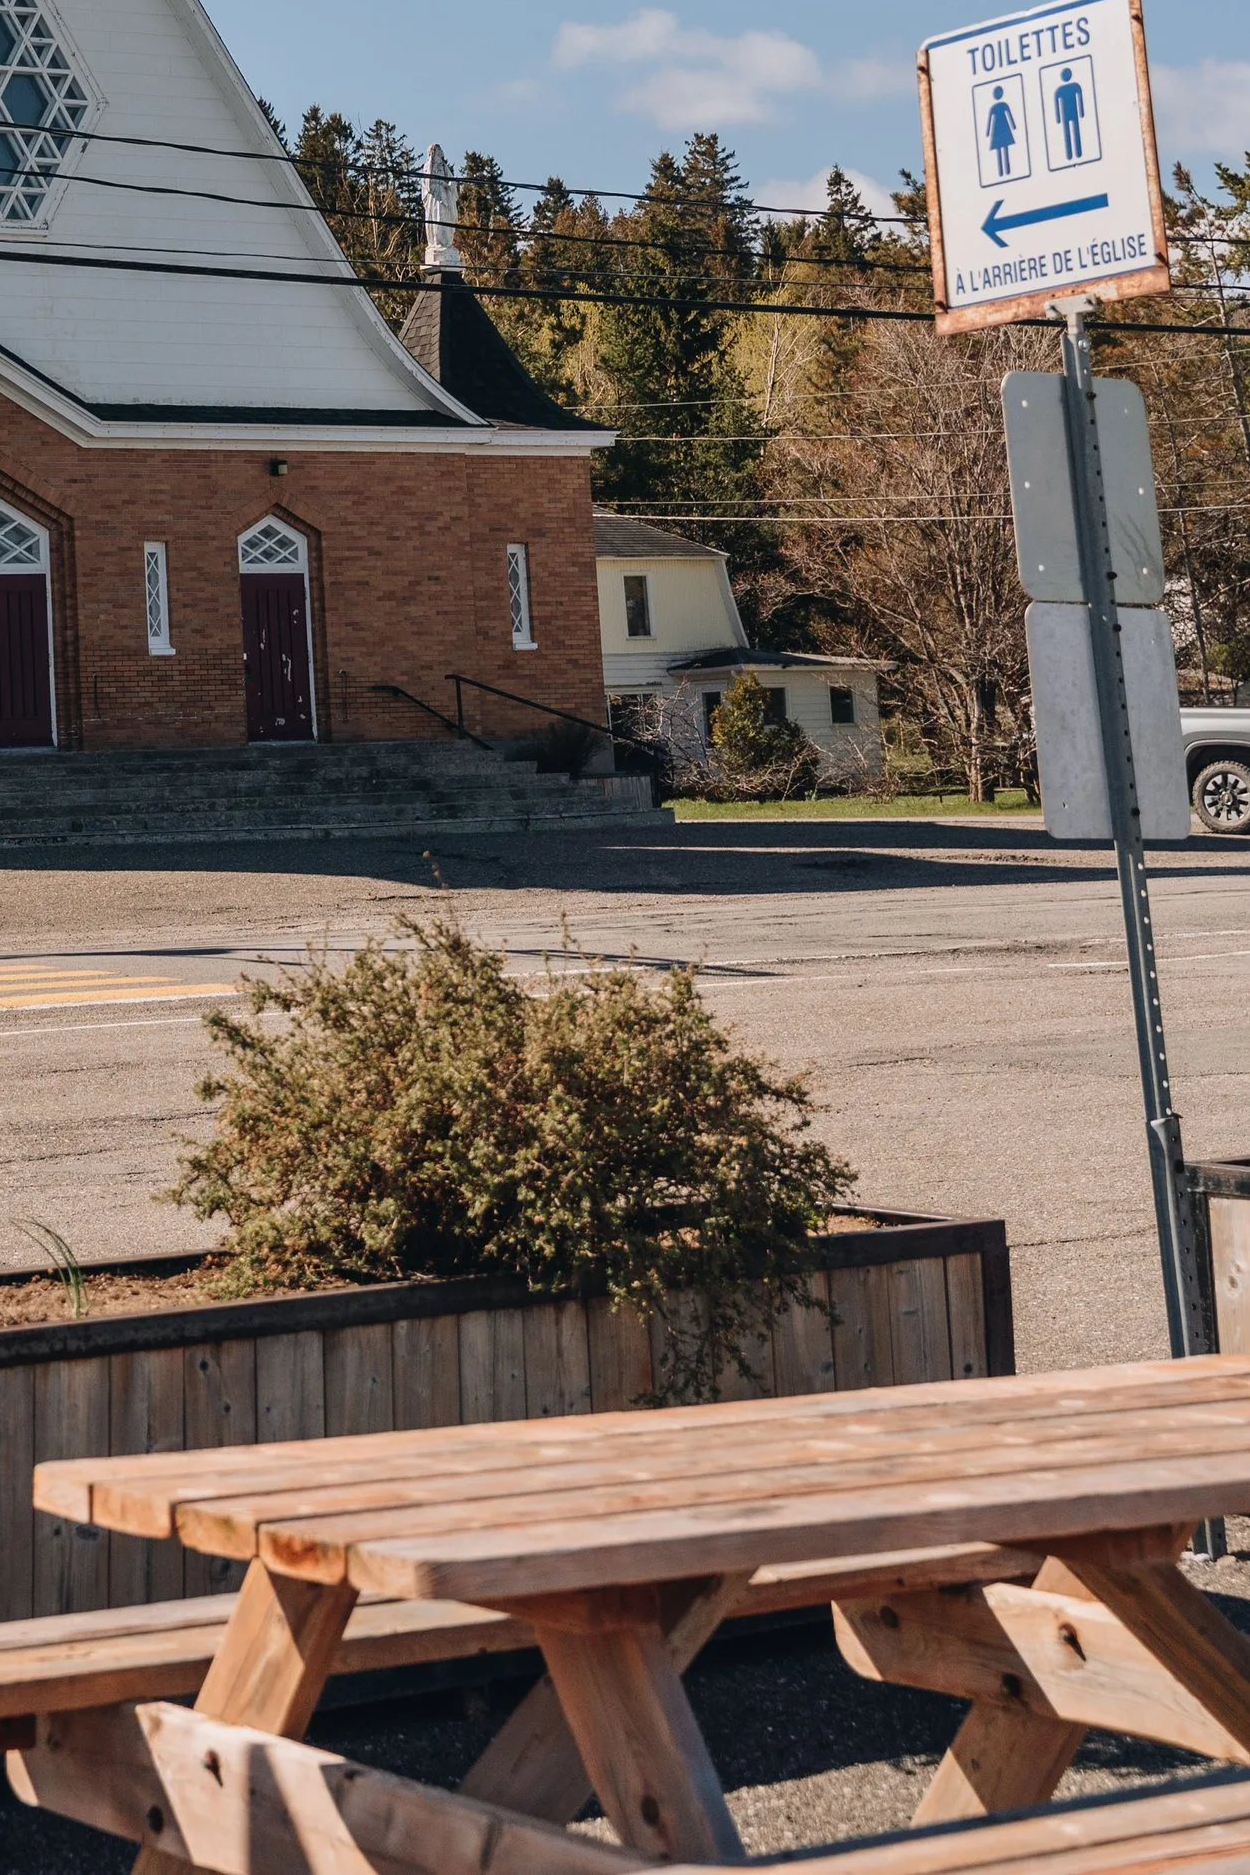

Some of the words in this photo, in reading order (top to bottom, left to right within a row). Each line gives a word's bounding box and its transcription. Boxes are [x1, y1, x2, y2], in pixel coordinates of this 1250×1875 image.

[967, 17, 1091, 75] TOILETTES
[956, 267, 966, 295] À
[970, 254, 1048, 292] L'ARRIÈRE
[1052, 249, 1074, 274] DE
[1078, 233, 1147, 269] L'ÉGLISE
